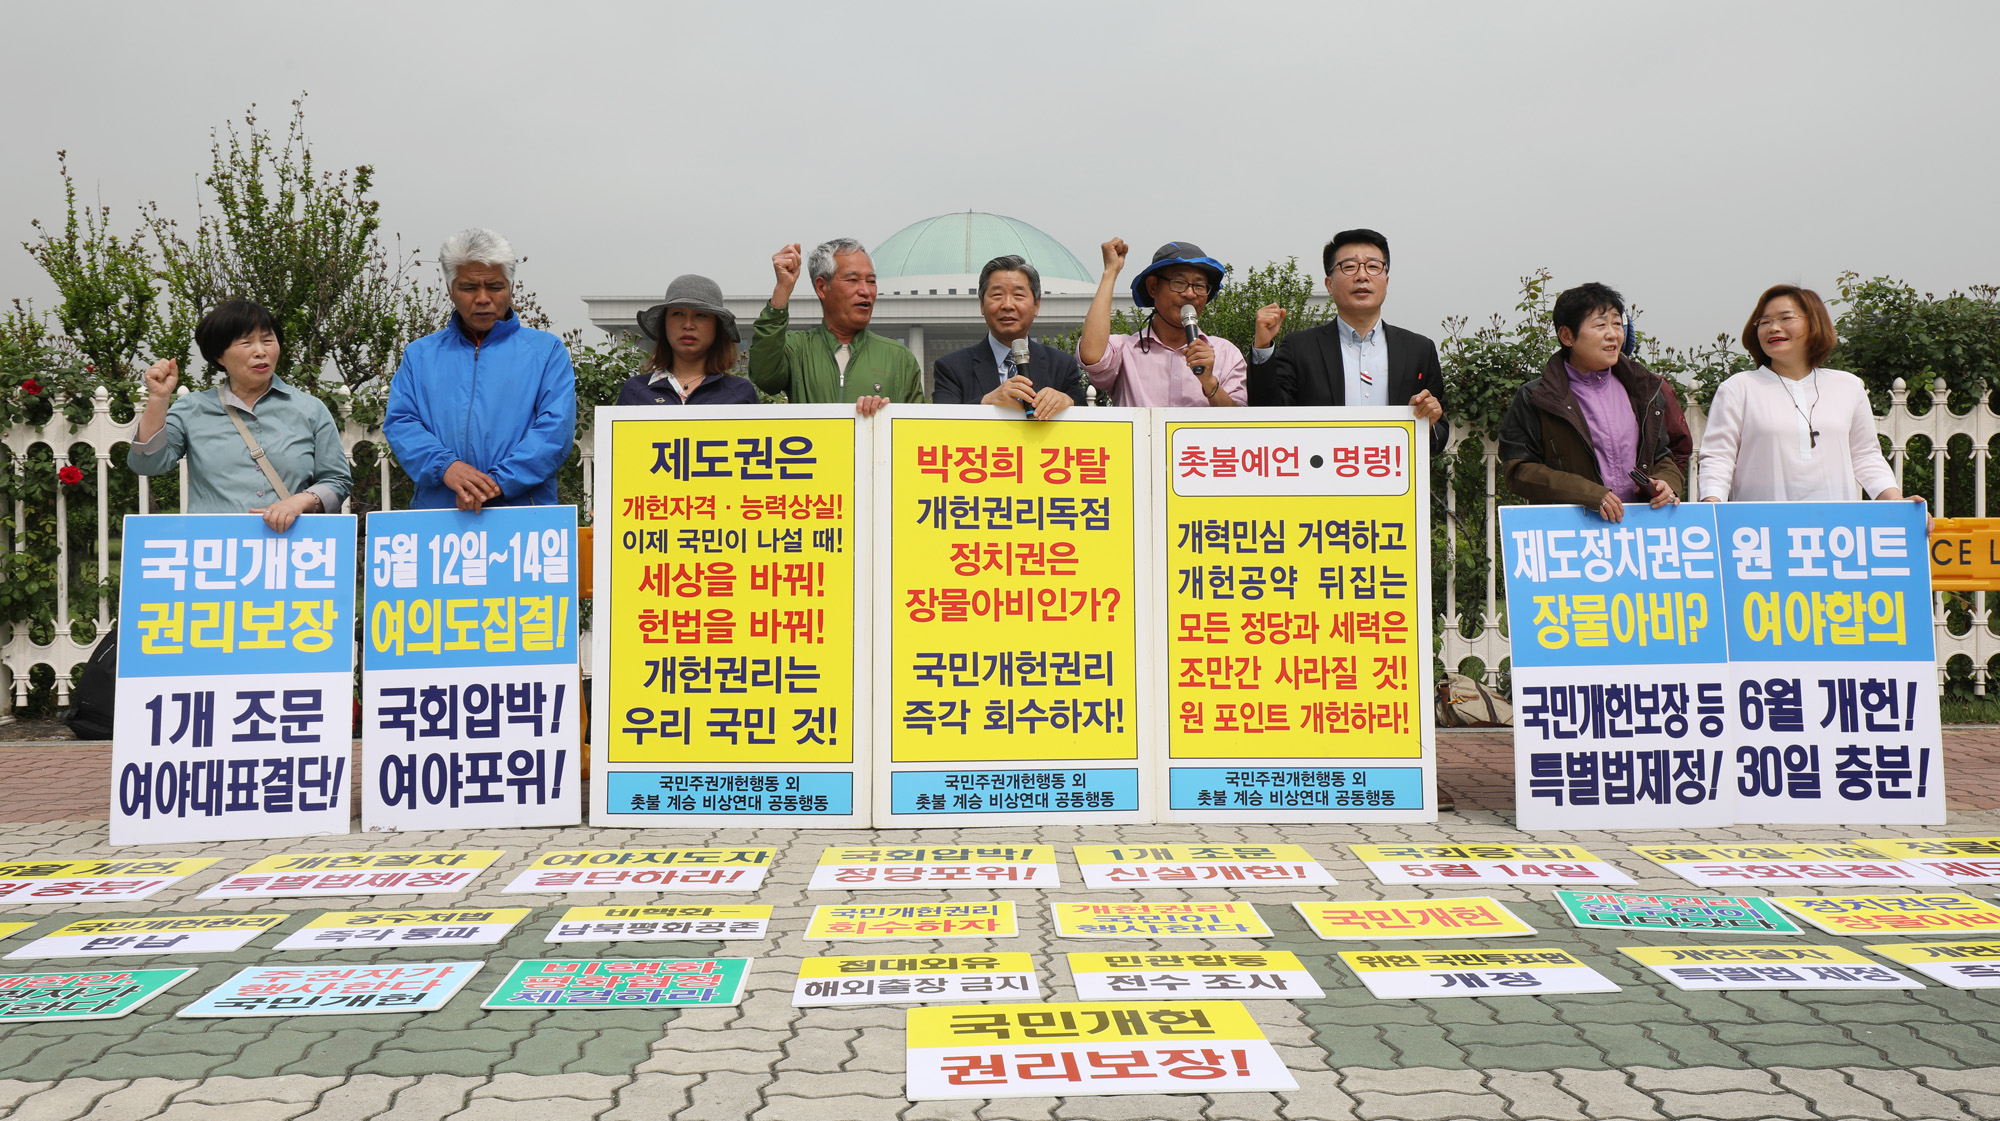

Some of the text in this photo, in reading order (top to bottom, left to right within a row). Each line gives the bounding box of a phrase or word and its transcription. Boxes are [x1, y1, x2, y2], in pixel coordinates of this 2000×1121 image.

[649, 436, 817, 482] 제도권은
[917, 445, 1110, 485] 박정희 강탈
[1178, 445, 1402, 478] 촛불예언 명령!
[622, 495, 716, 521] 개헌자격
[740, 494, 843, 520] 능력상실!
[916, 496, 1110, 531] 개헌권리독점
[622, 527, 843, 554] 이제 국민이 나설 때!
[1177, 519, 1407, 554] 개혁민심 거역하고
[373, 528, 569, 588] 5월 12일~14일
[949, 541, 1079, 577] 정치권은
[1511, 525, 1715, 583] 제도정치권은
[1732, 526, 1911, 581] 원 포인트
[141, 538, 336, 590] 국민개헌
[638, 561, 825, 598] 세상을 바꿔!
[1177, 565, 1408, 600] 개헌공약 뒤집는
[905, 587, 1121, 623] 장물아비인가?
[137, 599, 339, 655] 권리보장
[371, 595, 569, 656] 여의도집결!
[638, 608, 825, 645] 헌법을 바꿔!
[1532, 591, 1708, 650] 장물아비?
[1743, 590, 1907, 646] 여야합의
[1177, 611, 1408, 645] 모든 정당과 세력은
[643, 655, 820, 695] 개헌권리는
[912, 650, 1114, 688] 국민개헌권리
[1178, 655, 1408, 691] 조만간 사라질 것!
[377, 682, 566, 742] 국회압박!
[1522, 682, 1724, 740] 국민개헌보장 등
[1738, 677, 1918, 733] 6월 개헌!
[145, 689, 324, 748] 1개 조문
[902, 698, 1124, 735] 즉각 회수하자!
[1179, 701, 1409, 735] 원 포인트 개헌하라!
[622, 706, 838, 746] 우리 국민 것!
[379, 749, 567, 810] 여야포위!
[1225, 771, 1367, 788] 국민주권개헌행동 외
[1529, 748, 1723, 807] 특별법제정!
[1736, 744, 1931, 800] 30일 충분!
[119, 755, 345, 820] 여야대표결단!
[659, 775, 800, 792] 국민주권개헌행동 외
[944, 773, 1087, 790] 국민주권개헌행동 외
[630, 793, 829, 811] 촛불 계승 비상연대 공동행동
[915, 792, 1115, 810] 촛불 계승 비상연대 공동행동
[1197, 789, 1396, 807] 촛불 계승 비상연대 공동행동
[275, 853, 467, 869] 개헌절차
[543, 850, 770, 866] 여야지도자
[841, 848, 1034, 862] 국회압박!
[1105, 847, 1277, 861] 1개 조문
[1378, 847, 1577, 859] 국회응답!
[1644, 848, 1893, 861] 5월 12일~14일
[535, 869, 746, 887] 결단하라!
[834, 866, 1038, 883] 정당포위!
[1105, 865, 1307, 882] 신설개헌!
[1400, 863, 1600, 878] 5월 14일
[1692, 864, 1915, 880] 국회집결!
[31, 880, 165, 897] 충분!
[220, 872, 471, 892] 특별법제정!
[1072, 903, 1236, 915] 개헌권리
[1573, 893, 1753, 908] 개헌권리
[1794, 897, 1980, 914] 정치권은
[605, 907, 715, 918] 비핵화
[830, 904, 998, 919] 국민개헌권리
[1093, 914, 1222, 924] 국민이
[1322, 905, 1503, 930] 국민개헌
[65, 915, 277, 933] 국민개헌권리
[558, 921, 760, 936] 남북평화공존
[825, 918, 1000, 935] 회수하자
[1075, 923, 1251, 935] 행사한다
[1587, 913, 1778, 931] 나타났다
[313, 926, 480, 943] 즉각 통과
[1104, 955, 1268, 968] 민관합동
[1355, 952, 1577, 968] 위헌 국민투표법
[1661, 948, 1834, 961] 개헌절차
[541, 960, 723, 975] 비핵화
[836, 957, 1000, 973] 접대외유
[252, 966, 455, 984] 주권자가
[520, 974, 726, 989] 평화협정
[1106, 974, 1288, 992] 전수 조사
[1430, 971, 1543, 989] 개정
[1668, 966, 1900, 983] 특별법 제정
[237, 979, 443, 997] 행사한다
[506, 987, 721, 1004] 체결하라
[804, 975, 1029, 998] 해외출장 금지
[213, 992, 428, 1010] 국민개헌
[950, 1009, 1216, 1040] 국민개헌
[941, 1049, 1251, 1085] 권리보장!
